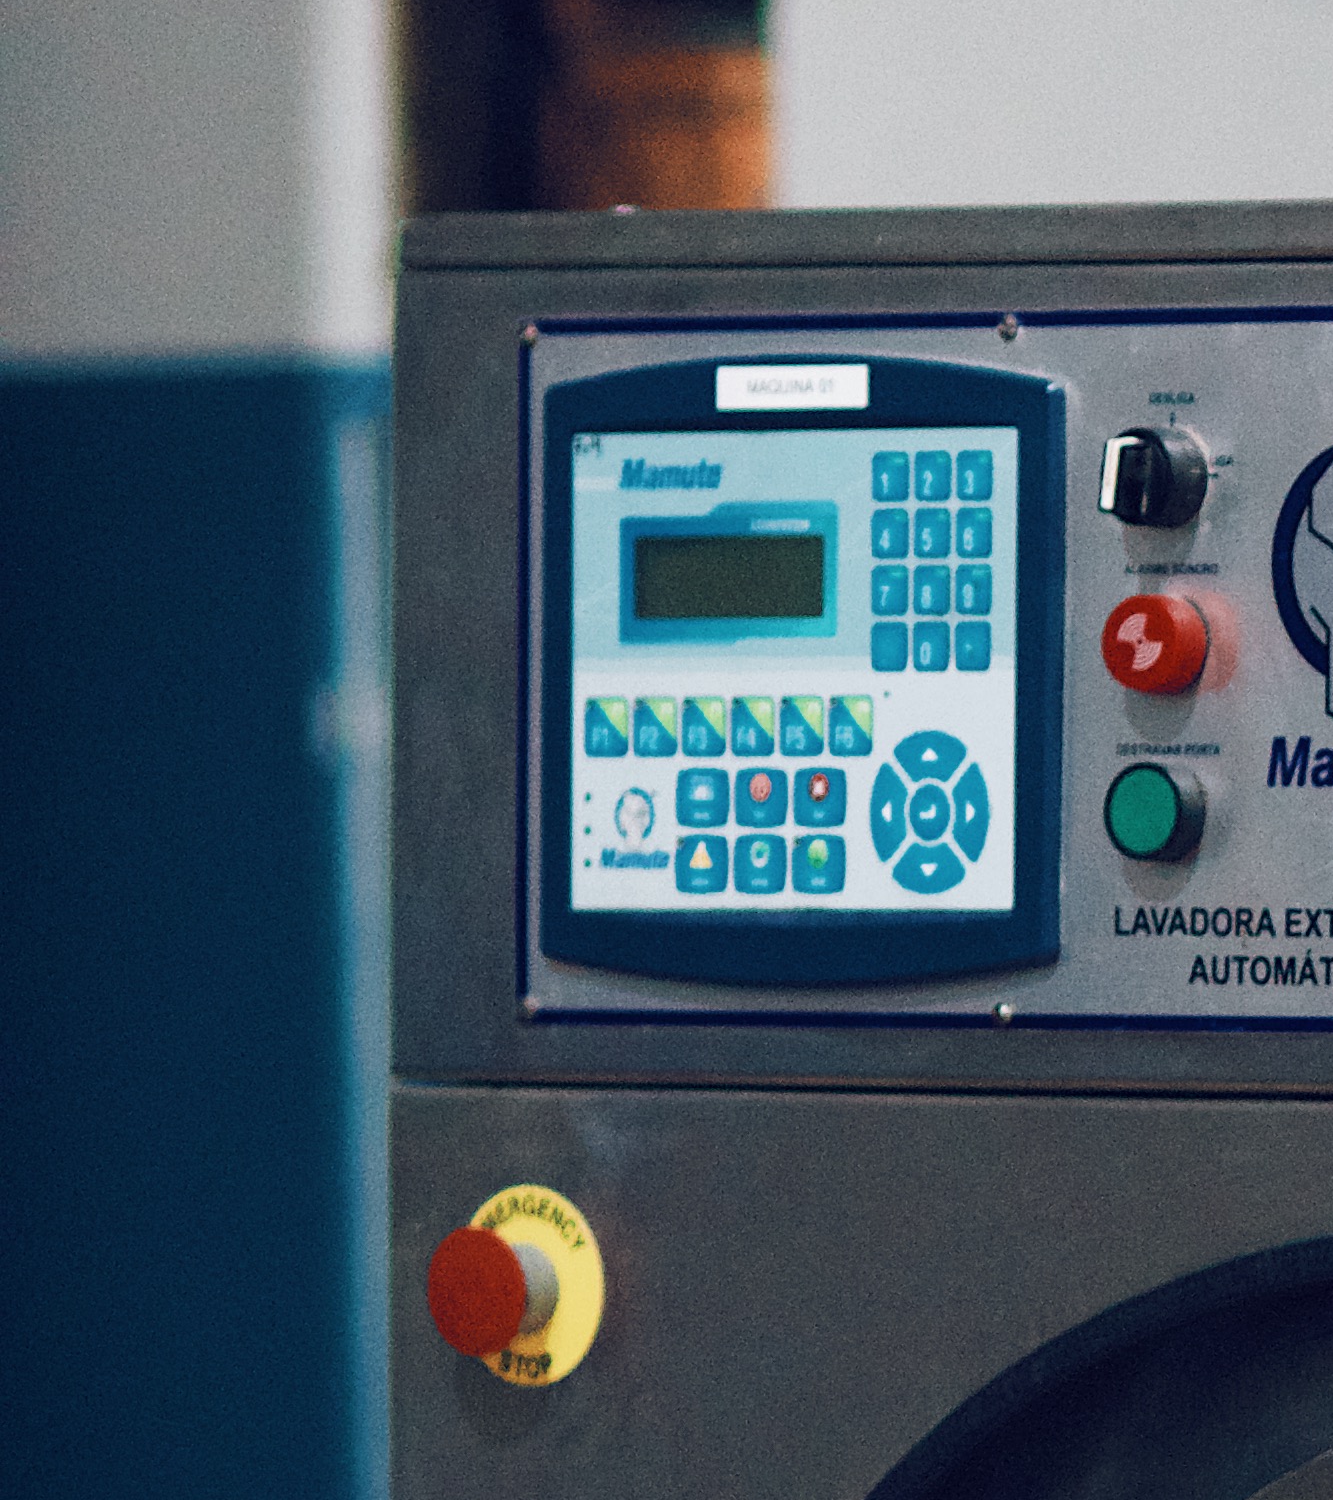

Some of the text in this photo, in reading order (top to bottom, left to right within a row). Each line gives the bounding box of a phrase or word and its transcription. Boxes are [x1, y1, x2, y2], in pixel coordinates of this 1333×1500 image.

[619, 457, 722, 490] Mamute
[880, 469, 975, 496] 1 2 3
[879, 526, 975, 552] 4 5 6
[879, 583, 975, 610] 7 8 9
[919, 640, 932, 666] 0
[639, 725, 659, 749] F2
[1114, 908, 1276, 938] LAVADORA
[481, 1194, 586, 1249] MERGENCY
[500, 1349, 553, 1379] STOP
